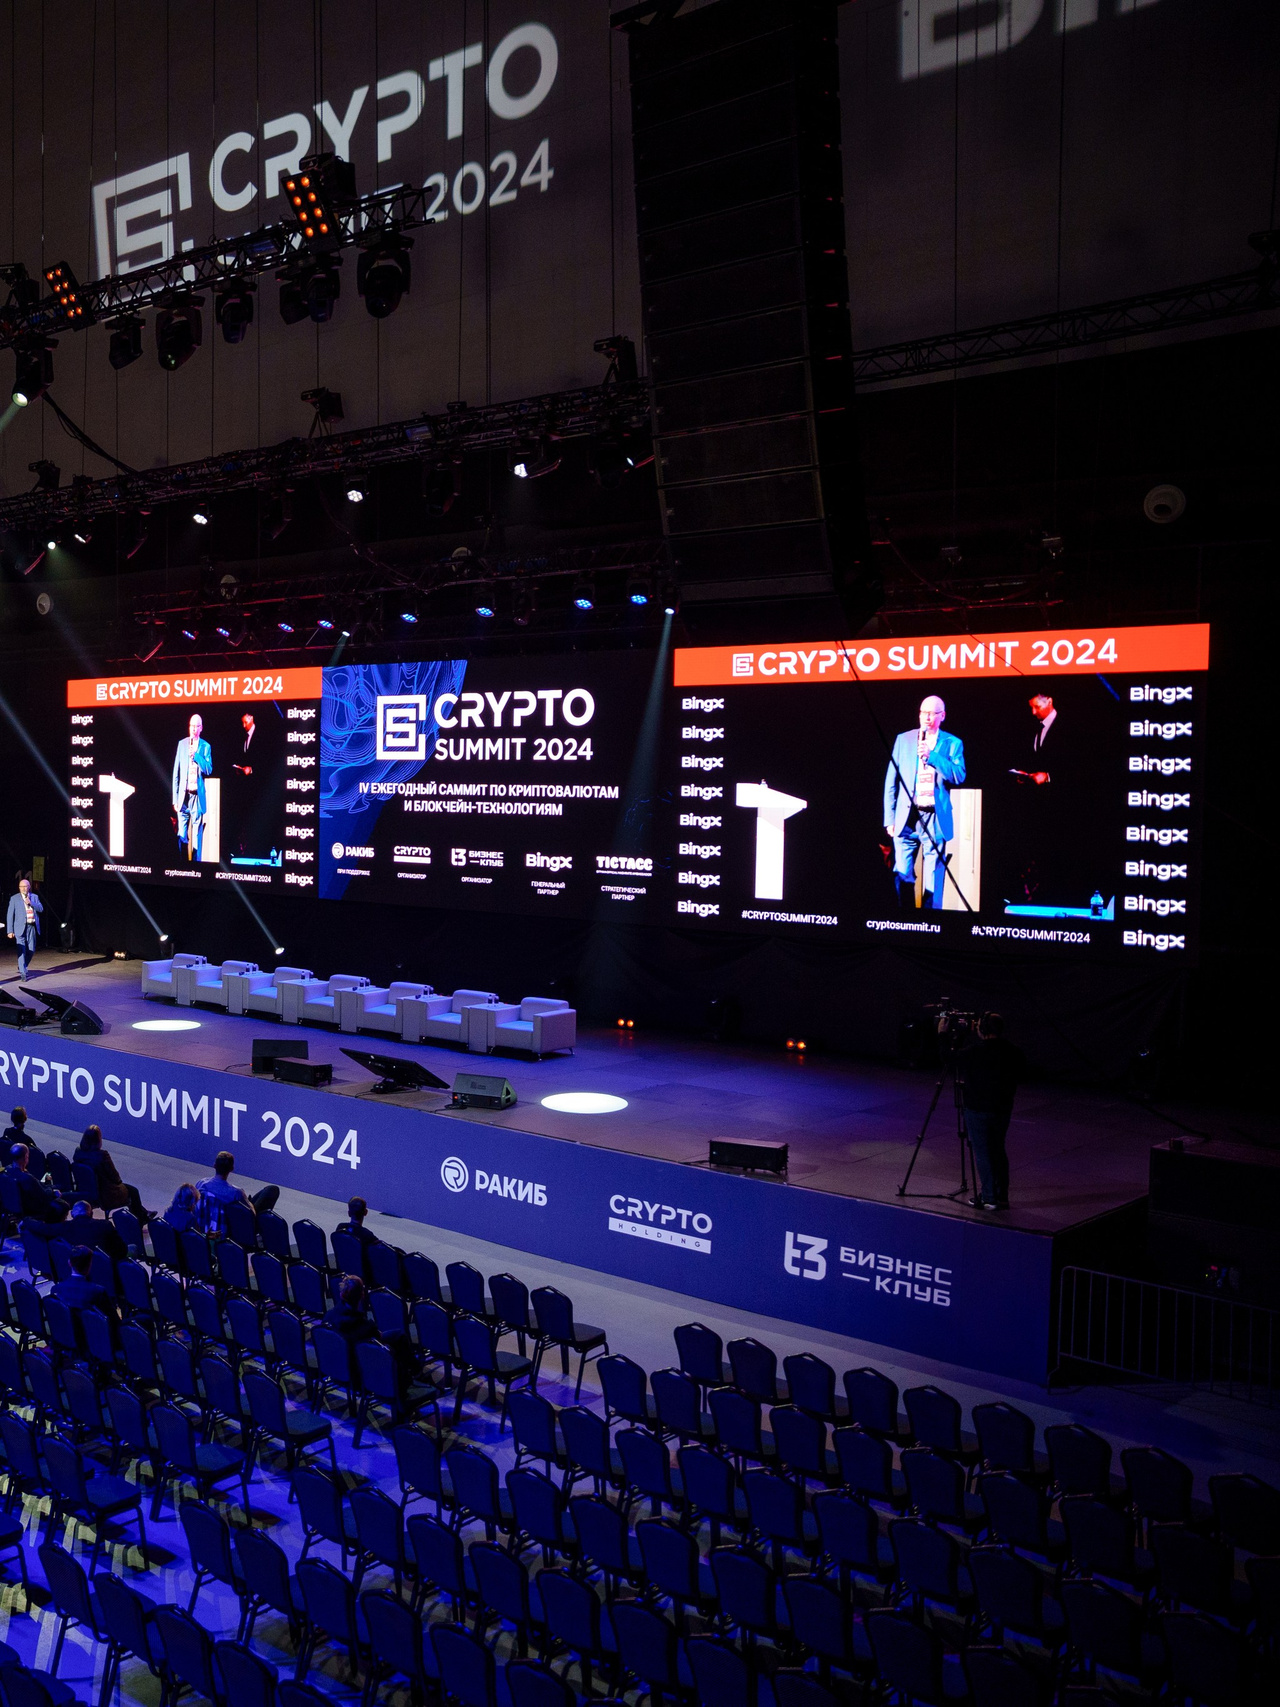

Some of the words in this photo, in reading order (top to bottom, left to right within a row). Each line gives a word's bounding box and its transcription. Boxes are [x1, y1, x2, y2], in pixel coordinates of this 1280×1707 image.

[208, 21, 558, 212] CRYPTO
[423, 138, 554, 223] 2024
[757, 647, 881, 676] CRYPTO
[887, 641, 1020, 671] SUMMIT
[1030, 637, 1118, 667] 2024
[108, 680, 171, 700] CRYPTO
[173, 677, 238, 697] SUMMIT
[242, 675, 283, 695] 2024
[1130, 685, 1193, 704] Bingx
[433, 688, 595, 729] CRYPTO
[1130, 720, 1192, 740] Bingx
[434, 737, 527, 761] SUMMIT
[532, 737, 594, 761] 2024
[1129, 755, 1191, 775] Bingx
[358, 782, 370, 794] IV
[371, 781, 437, 797] ЕЖЕГОДНЫЙ
[438, 783, 489, 797] САММИТ
[489, 785, 507, 797] ПО
[508, 785, 619, 799] КРИПТОВАЛЮТАМ
[1128, 790, 1190, 810] Bingx
[403, 800, 413, 812] И
[413, 800, 563, 816] БЛОКЧЕЙН-ТЕХНОЛОГИЯМ
[1126, 825, 1188, 846] Bingx
[345, 846, 375, 858] РАКИБ
[394, 845, 431, 857] CRYPTO
[469, 850, 504, 859] БИЗНЕС
[103, 864, 152, 875] #CRYPTOSUMMIT2024
[164, 869, 202, 878] cryptosummit.ru
[596, 856, 653, 871] TICTACC
[1125, 860, 1187, 881] Bingx
[215, 871, 272, 883] #CRYPTOSUMMIT2024
[397, 872, 427, 880] ОРГАНИЗАТОР
[531, 880, 566, 889] ГЕНЕРАЛЬНЫЙ
[537, 888, 559, 896] ПАРТНЕР
[601, 885, 647, 895] СТРАТЕГИЧЕСКИЙ
[612, 893, 635, 901] ПАРТНЕР
[1124, 895, 1186, 916] Bingx
[741, 909, 839, 926] #CRYPTOSUMMIT2024
[866, 918, 941, 934] cryptosummit.ru
[1123, 930, 1185, 951] Bingx
[104, 1074, 247, 1142] SUMMIT
[260, 1111, 361, 1170] 2024
[475, 1169, 548, 1206] РАКИБ
[609, 1194, 713, 1234] CRYPTO
[618, 1223, 701, 1248] HOLDING
[840, 1246, 952, 1286] БИЗНЕС
